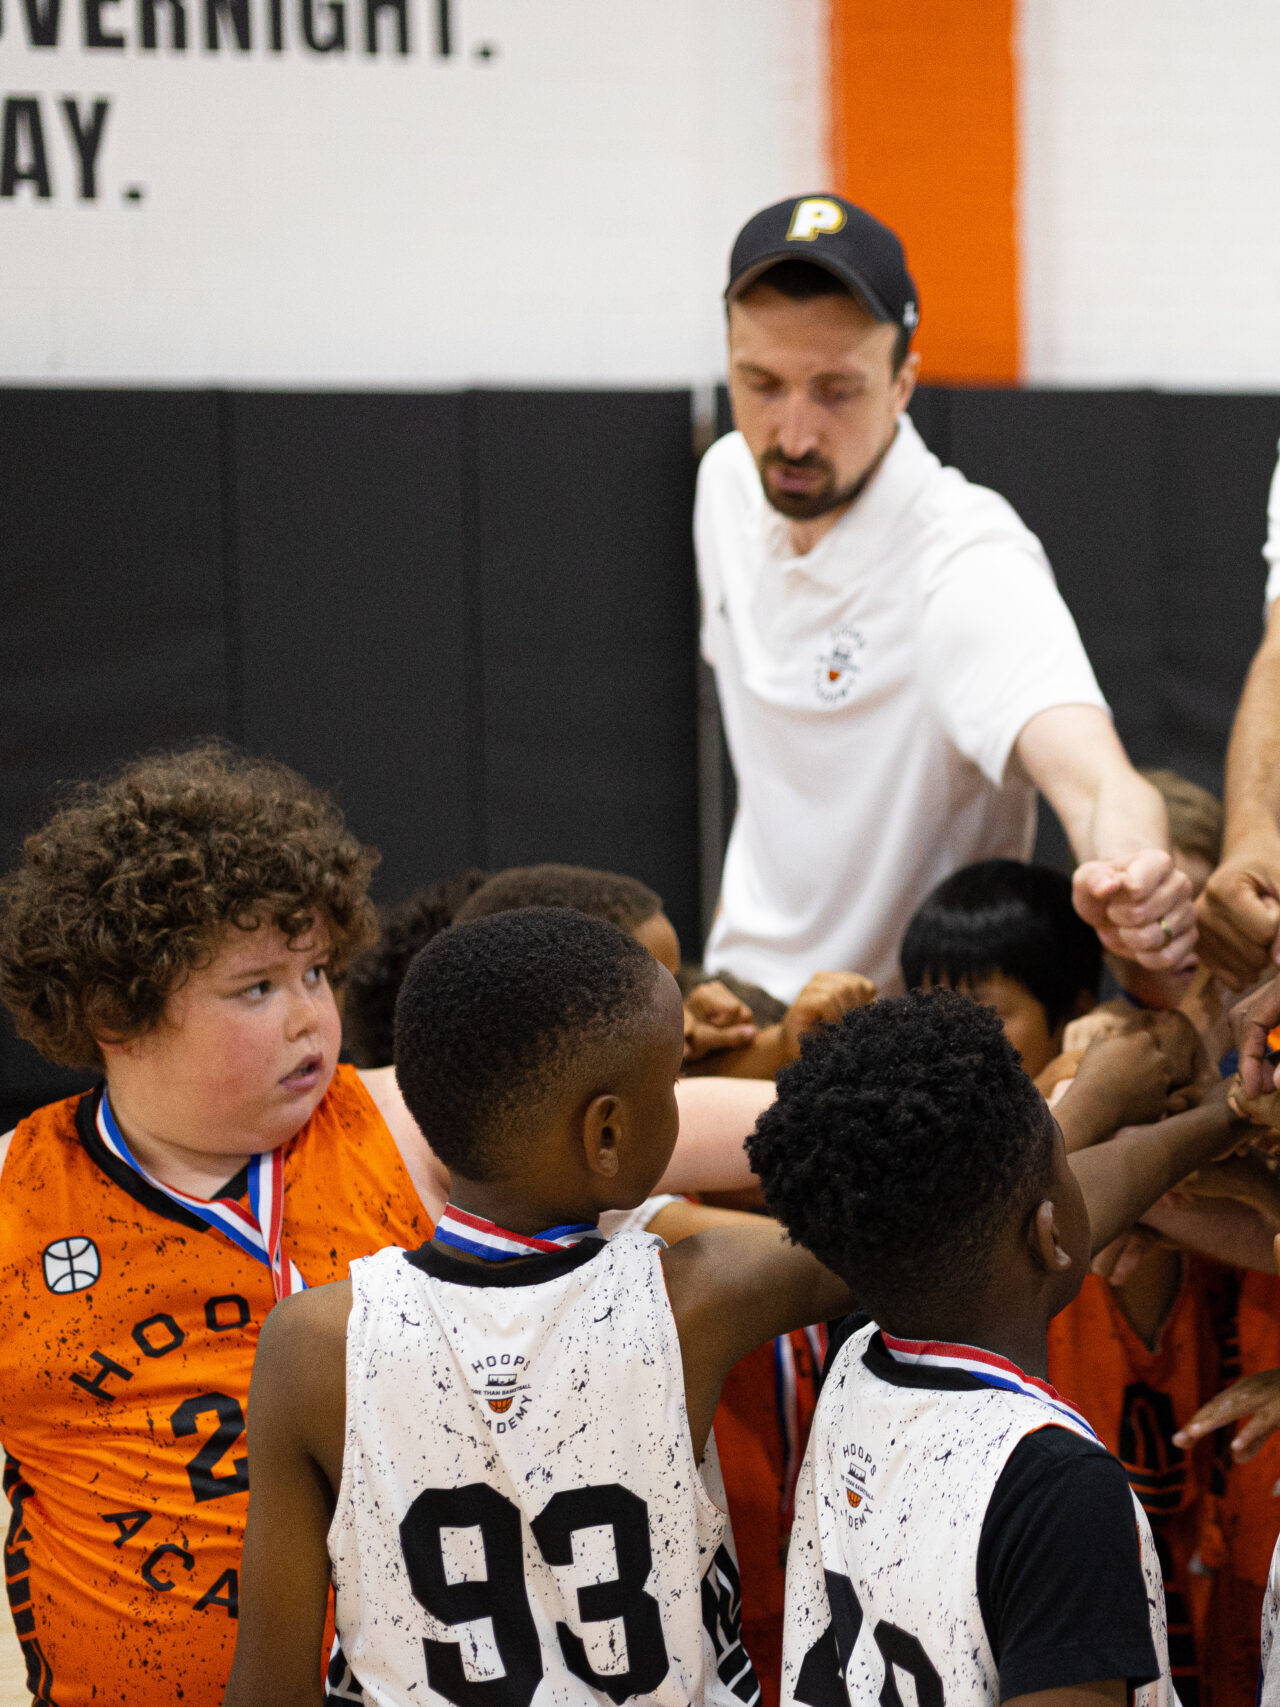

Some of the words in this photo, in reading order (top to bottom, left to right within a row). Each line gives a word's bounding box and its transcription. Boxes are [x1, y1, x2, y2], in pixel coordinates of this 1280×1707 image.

[785, 197, 847, 242] P
[481, 1394, 533, 1434] ADEMY
[842, 1443, 877, 1477] HOOPS
[398, 1481, 671, 1707] 93
